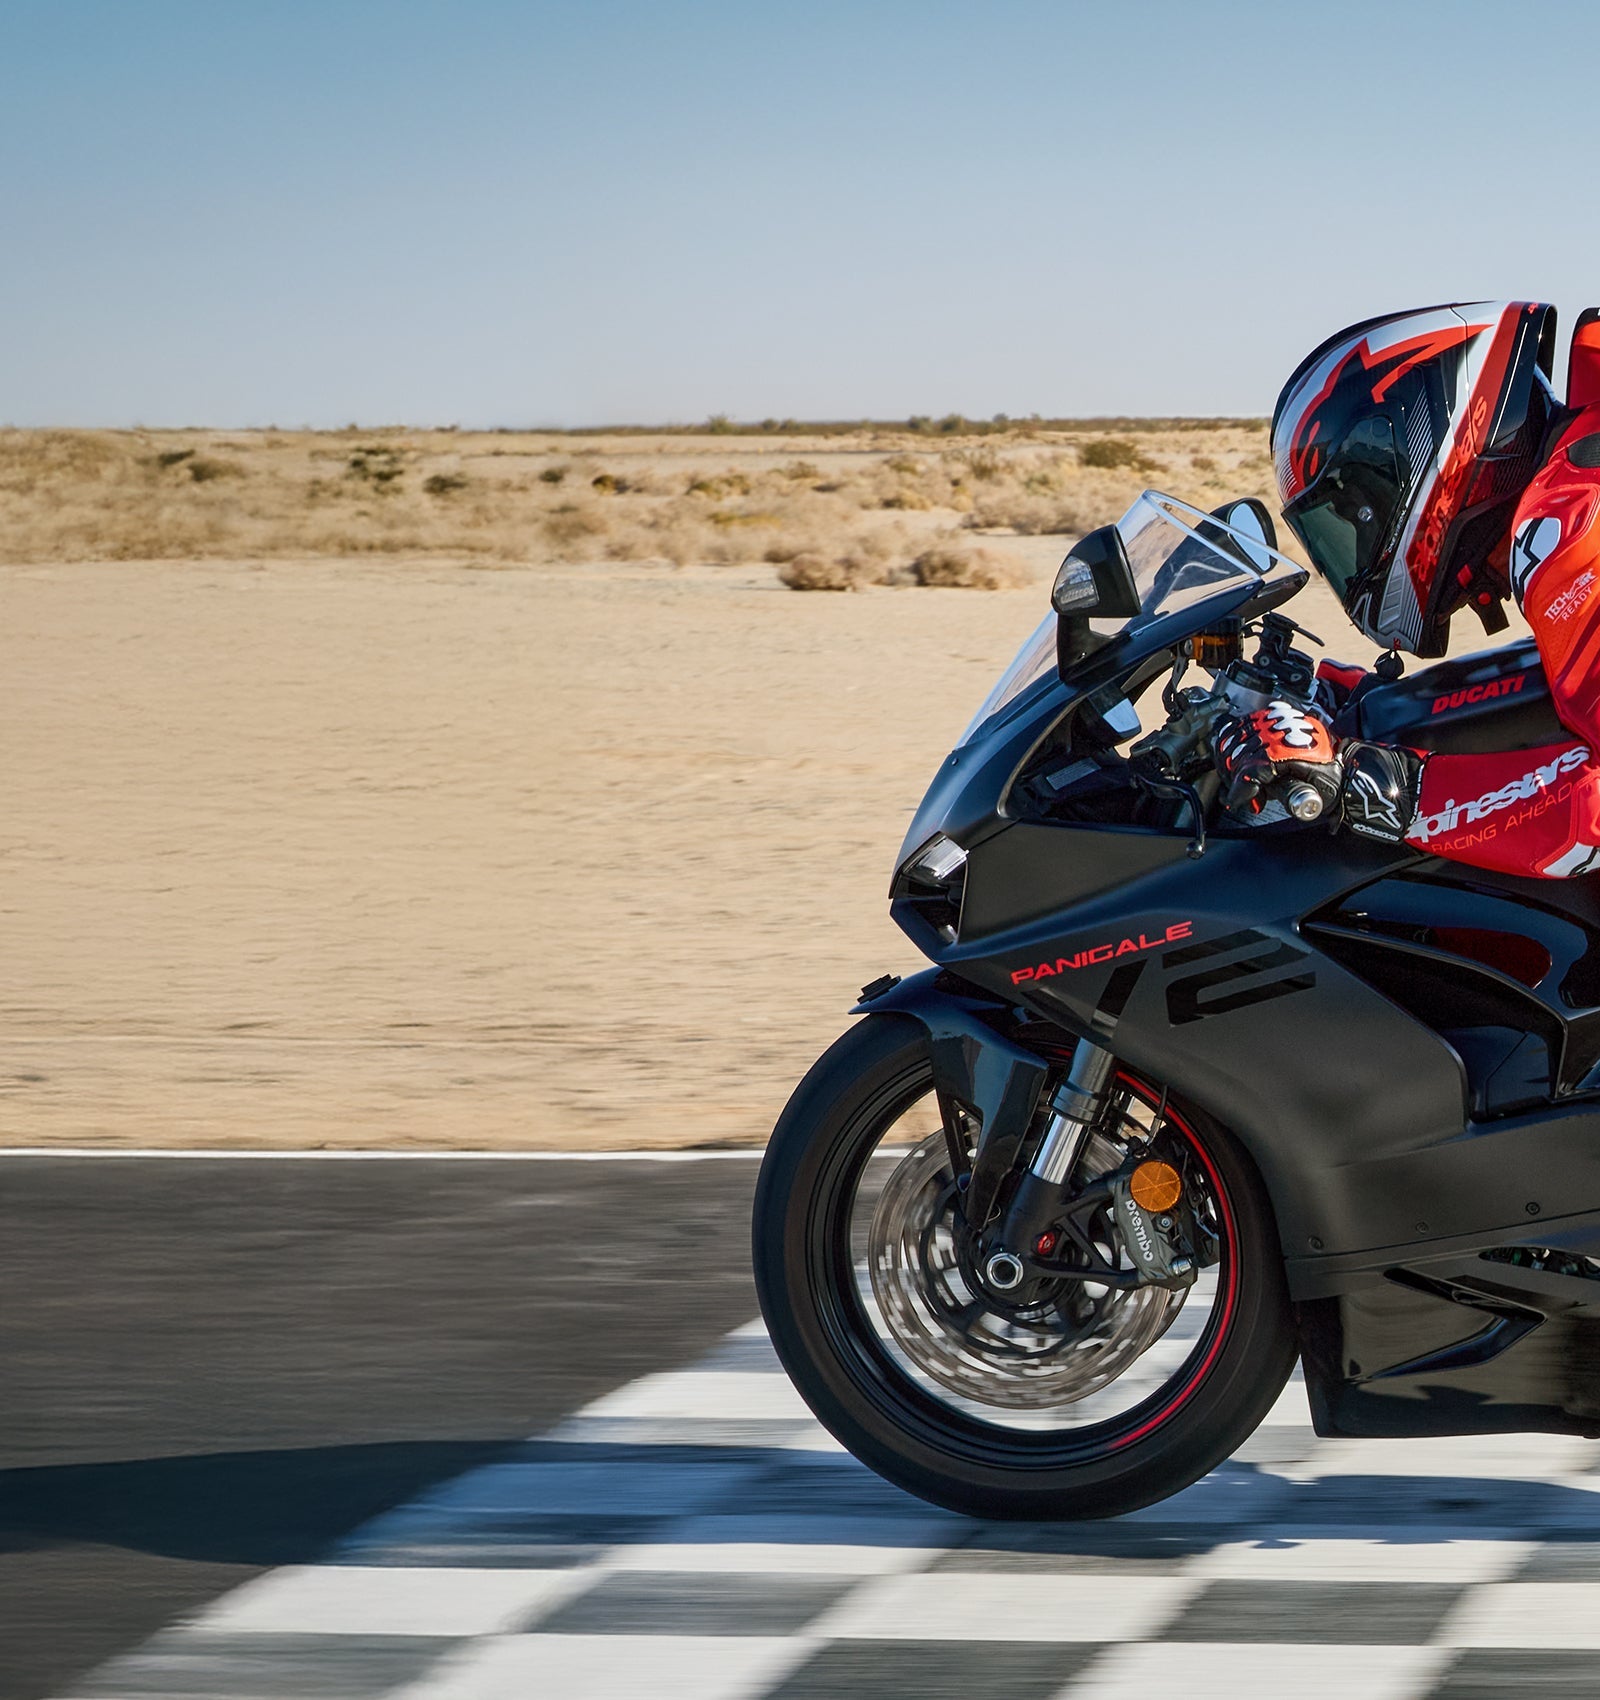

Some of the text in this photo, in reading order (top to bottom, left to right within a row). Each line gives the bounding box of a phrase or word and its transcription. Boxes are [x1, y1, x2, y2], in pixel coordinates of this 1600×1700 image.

[1561, 586, 1592, 621] READY
[1431, 674, 1525, 715] DUCATI
[1431, 782, 1572, 852] RACING AHEAD
[1010, 920, 1193, 985] PANIGALE
[1124, 1199, 1154, 1262] brembo
